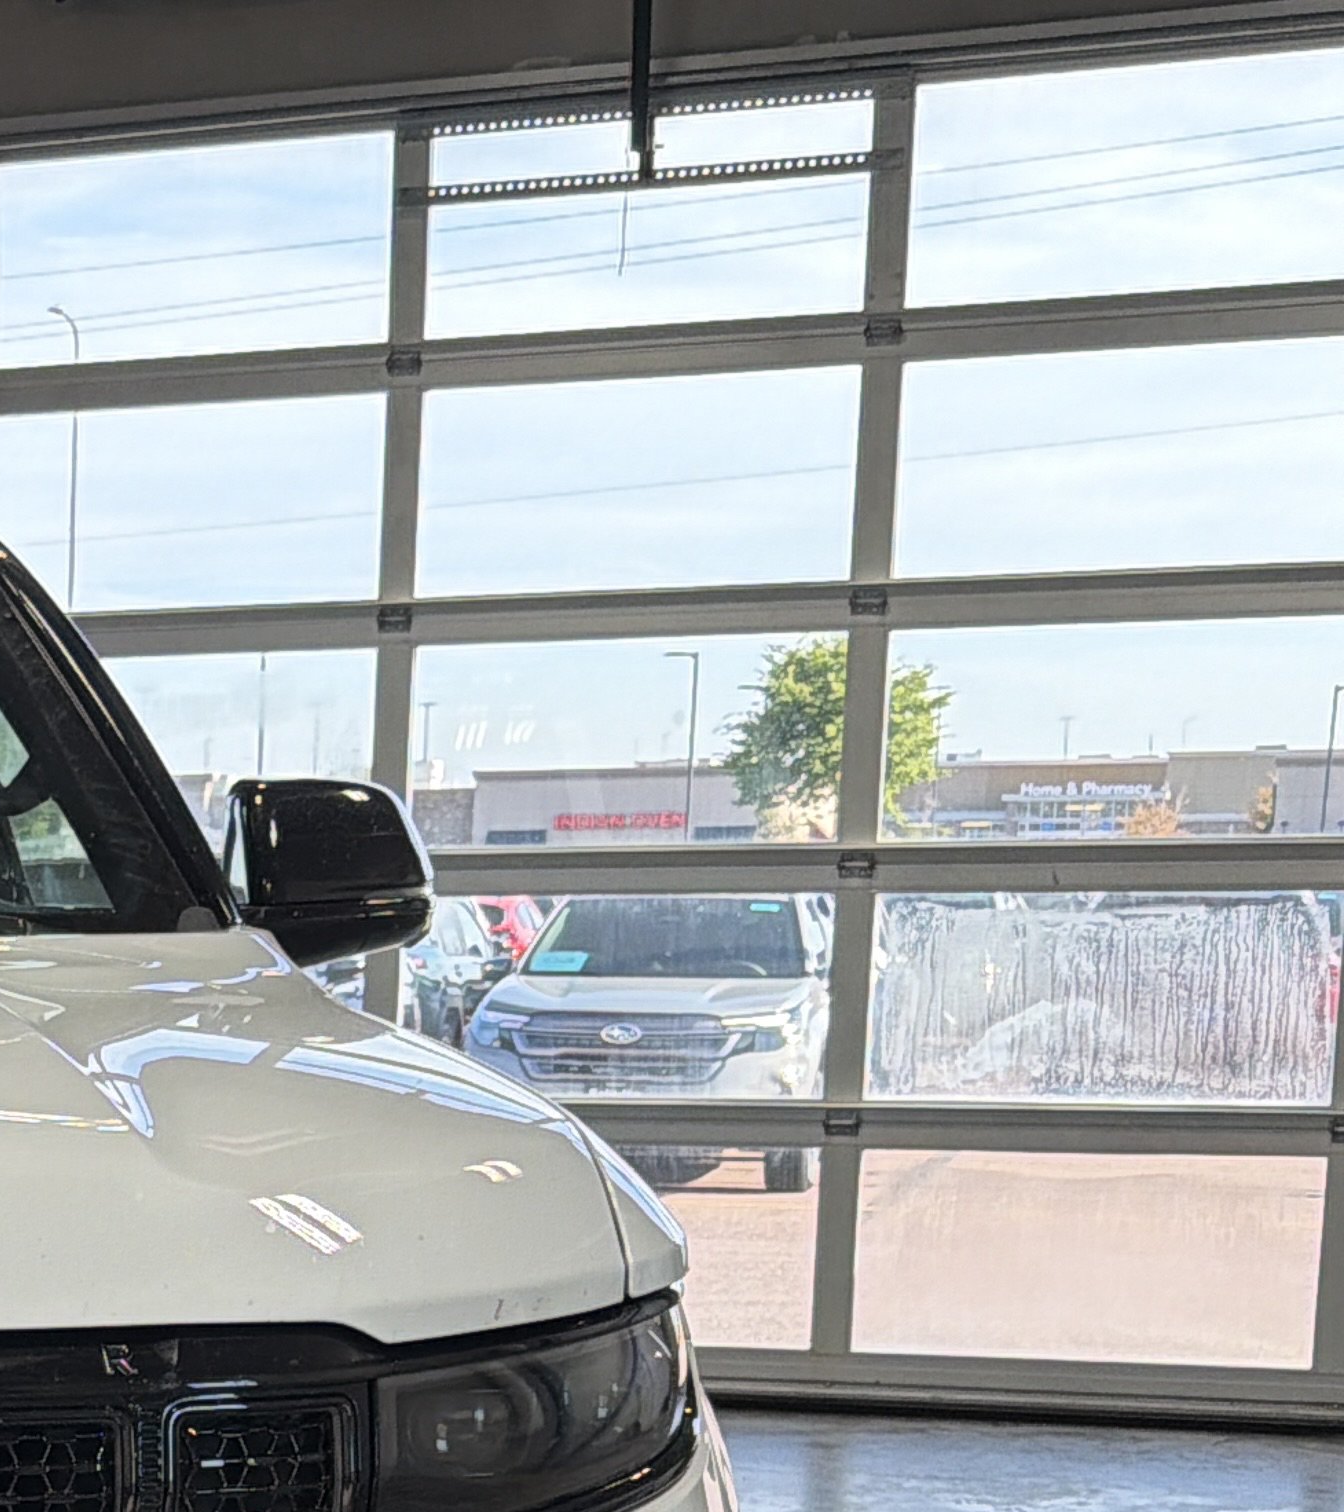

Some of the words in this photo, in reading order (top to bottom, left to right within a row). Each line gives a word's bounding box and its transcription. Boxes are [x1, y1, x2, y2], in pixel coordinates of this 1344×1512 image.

[1020, 782, 1062, 797] Home
[1066, 781, 1077, 796] &
[1082, 781, 1152, 799] Pharmacy
[554, 814, 625, 831] INDIAN
